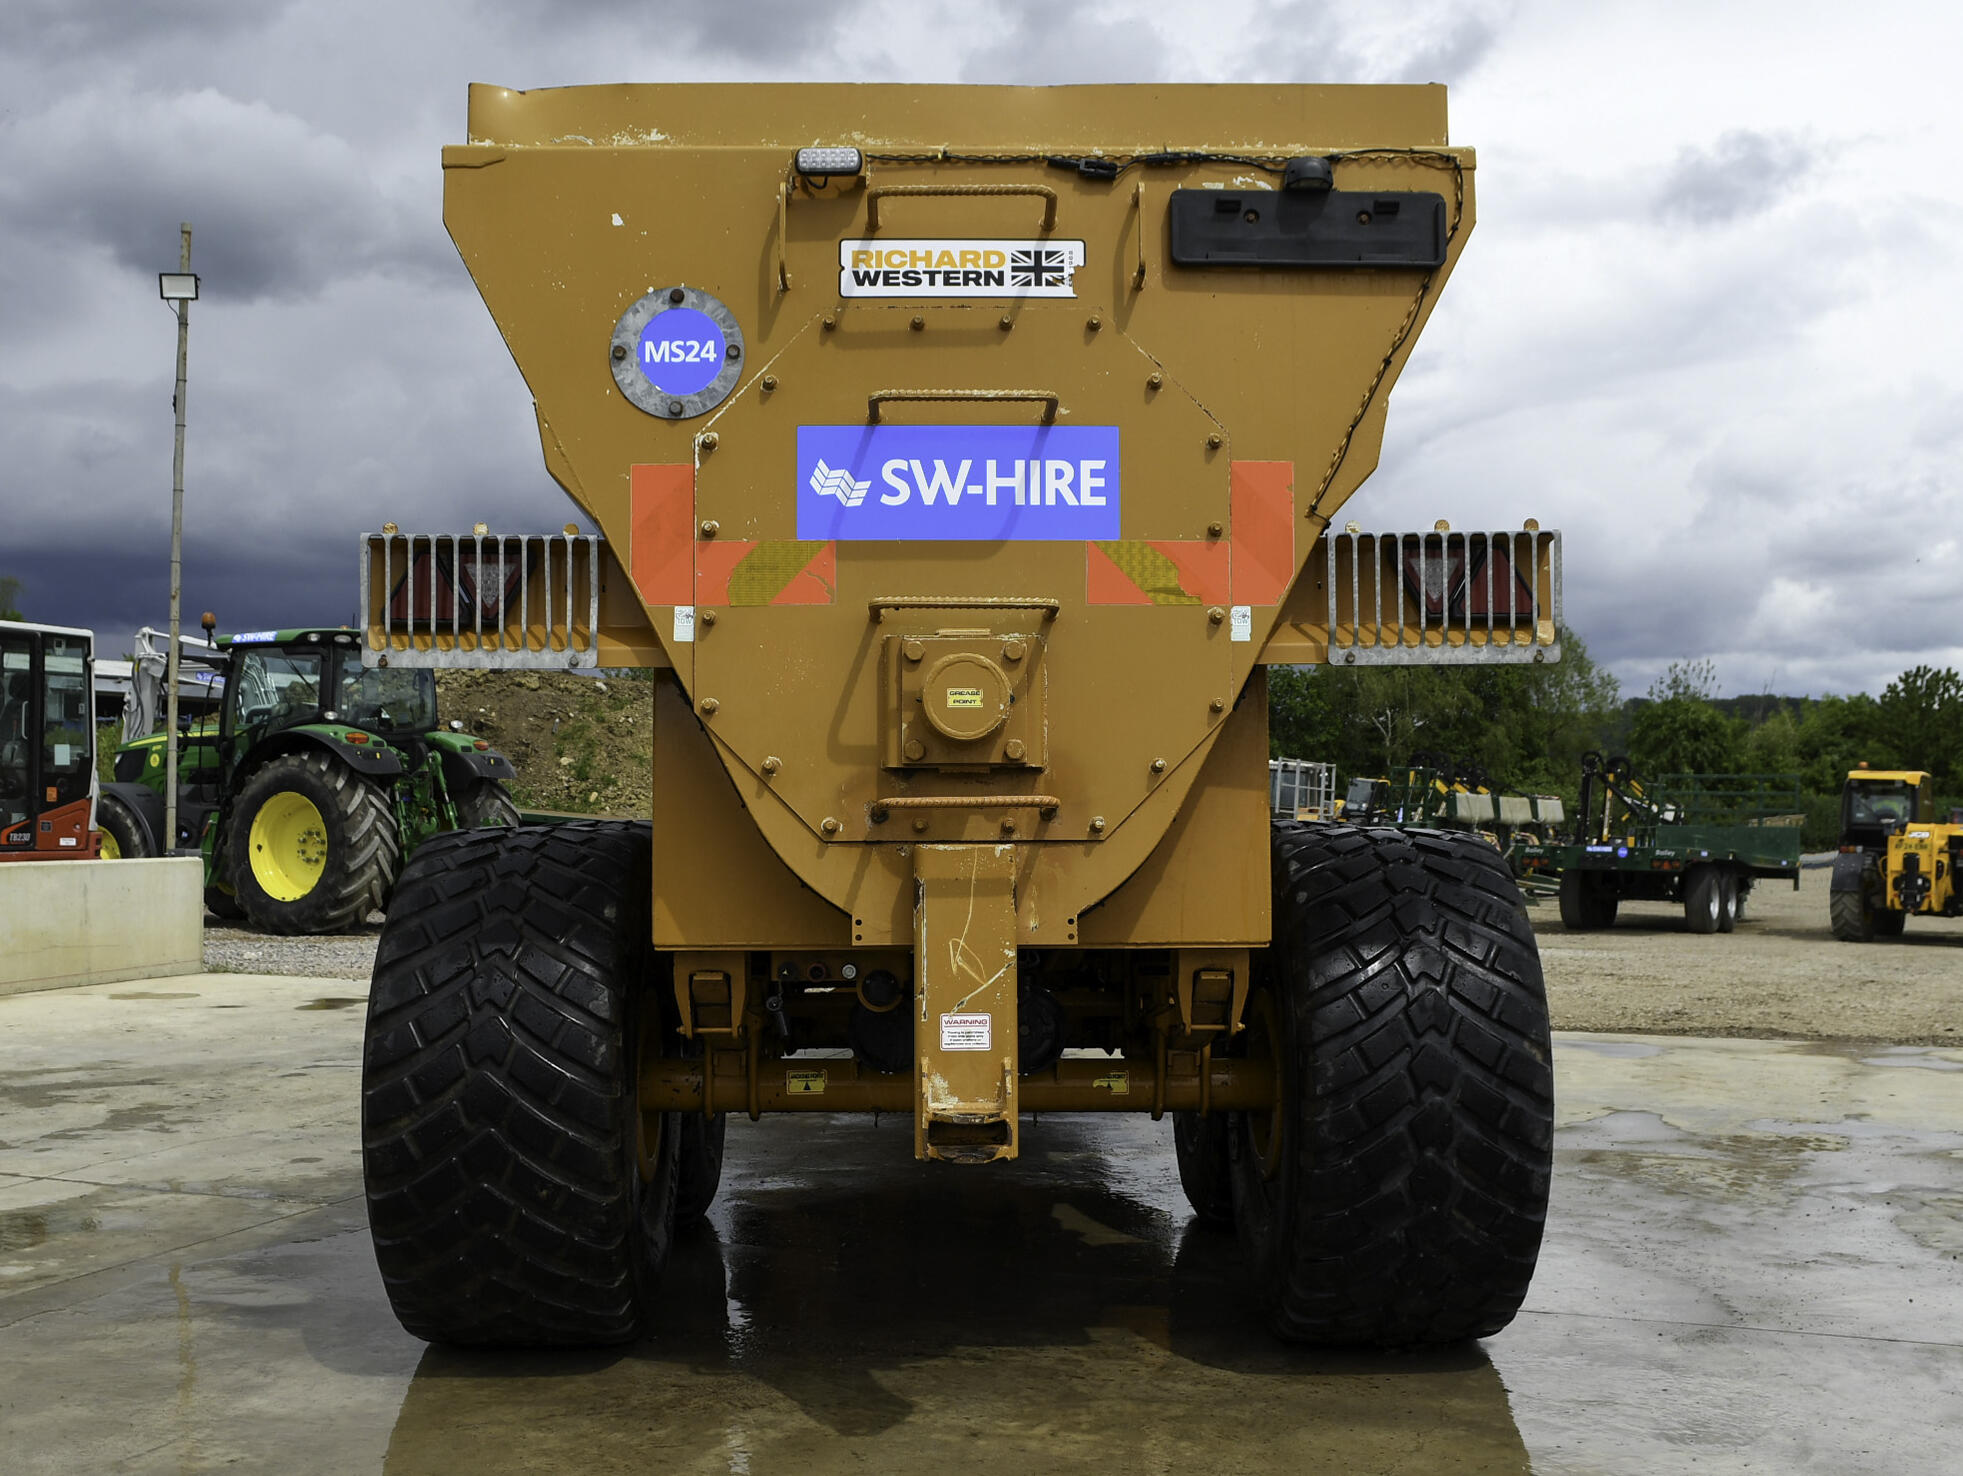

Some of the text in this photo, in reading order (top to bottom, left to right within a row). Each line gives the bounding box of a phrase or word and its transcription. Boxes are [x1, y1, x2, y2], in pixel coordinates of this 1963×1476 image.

[852, 250, 1006, 269] RICHARD
[852, 270, 1004, 287] WESTERN
[645, 340, 717, 363] MS24
[880, 459, 1106, 506] SW-HIRE
